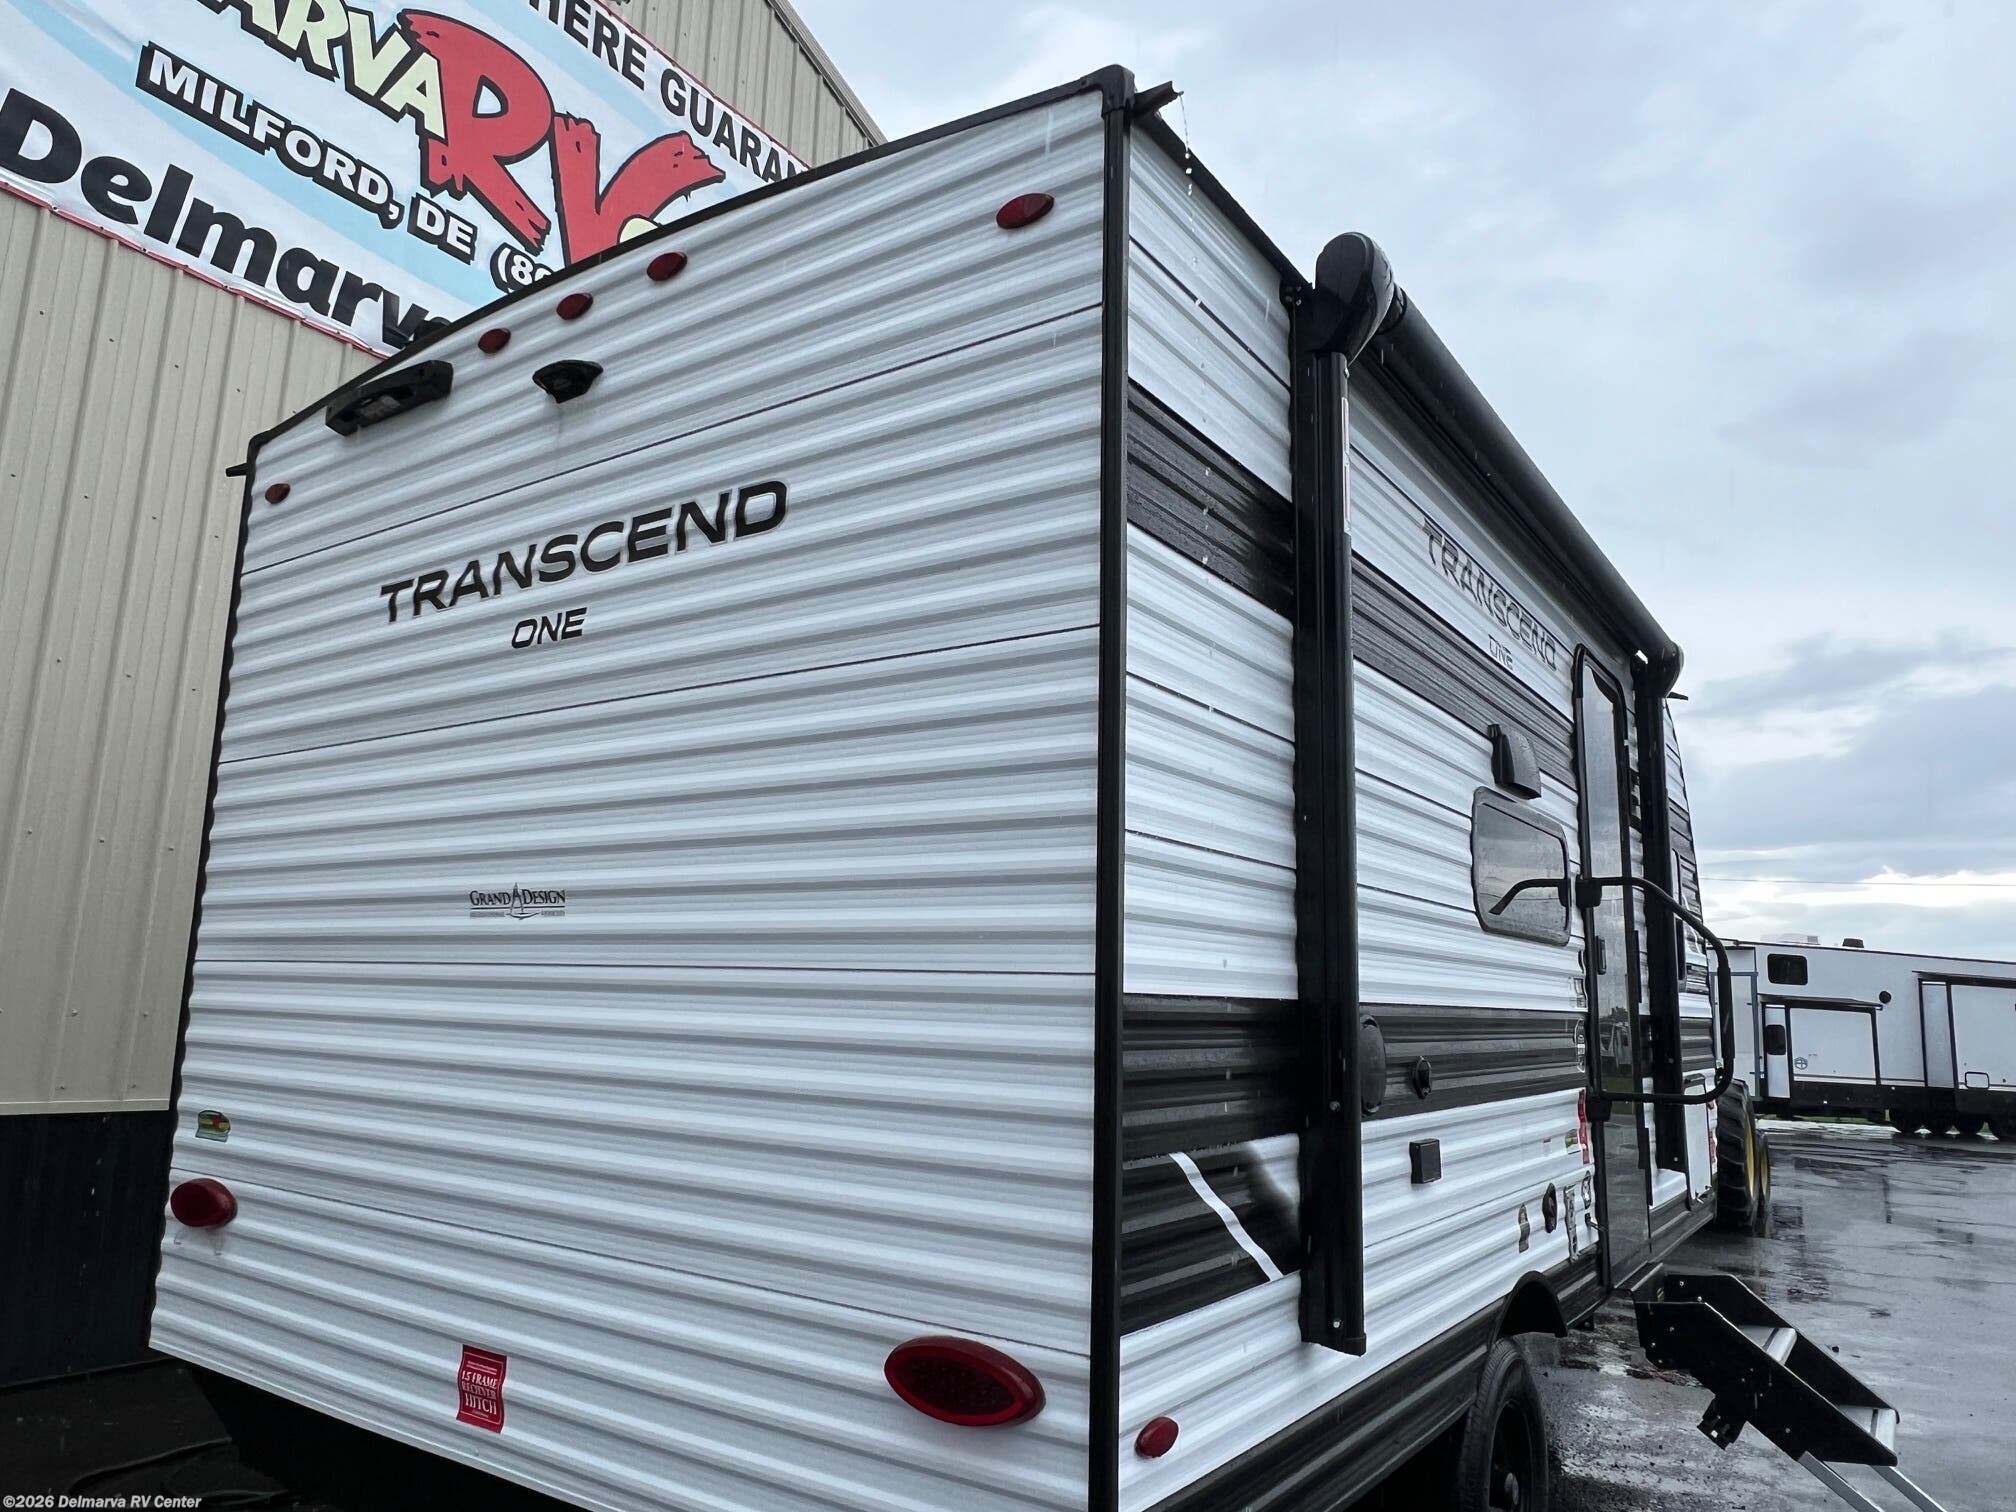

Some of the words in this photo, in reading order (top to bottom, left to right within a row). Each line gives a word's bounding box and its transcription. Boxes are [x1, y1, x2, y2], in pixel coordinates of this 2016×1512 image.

[142, 46, 402, 224] MILFORD,
[411, 199, 476, 260] DE
[380, 480, 788, 623] TRANSCEND
[1422, 517, 1557, 673] TRANSCEND
[511, 607, 588, 649] ONE
[469, 890, 511, 906] GRAND
[522, 888, 566, 905] DESIGN
[465, 1393, 497, 1415] HITCH
